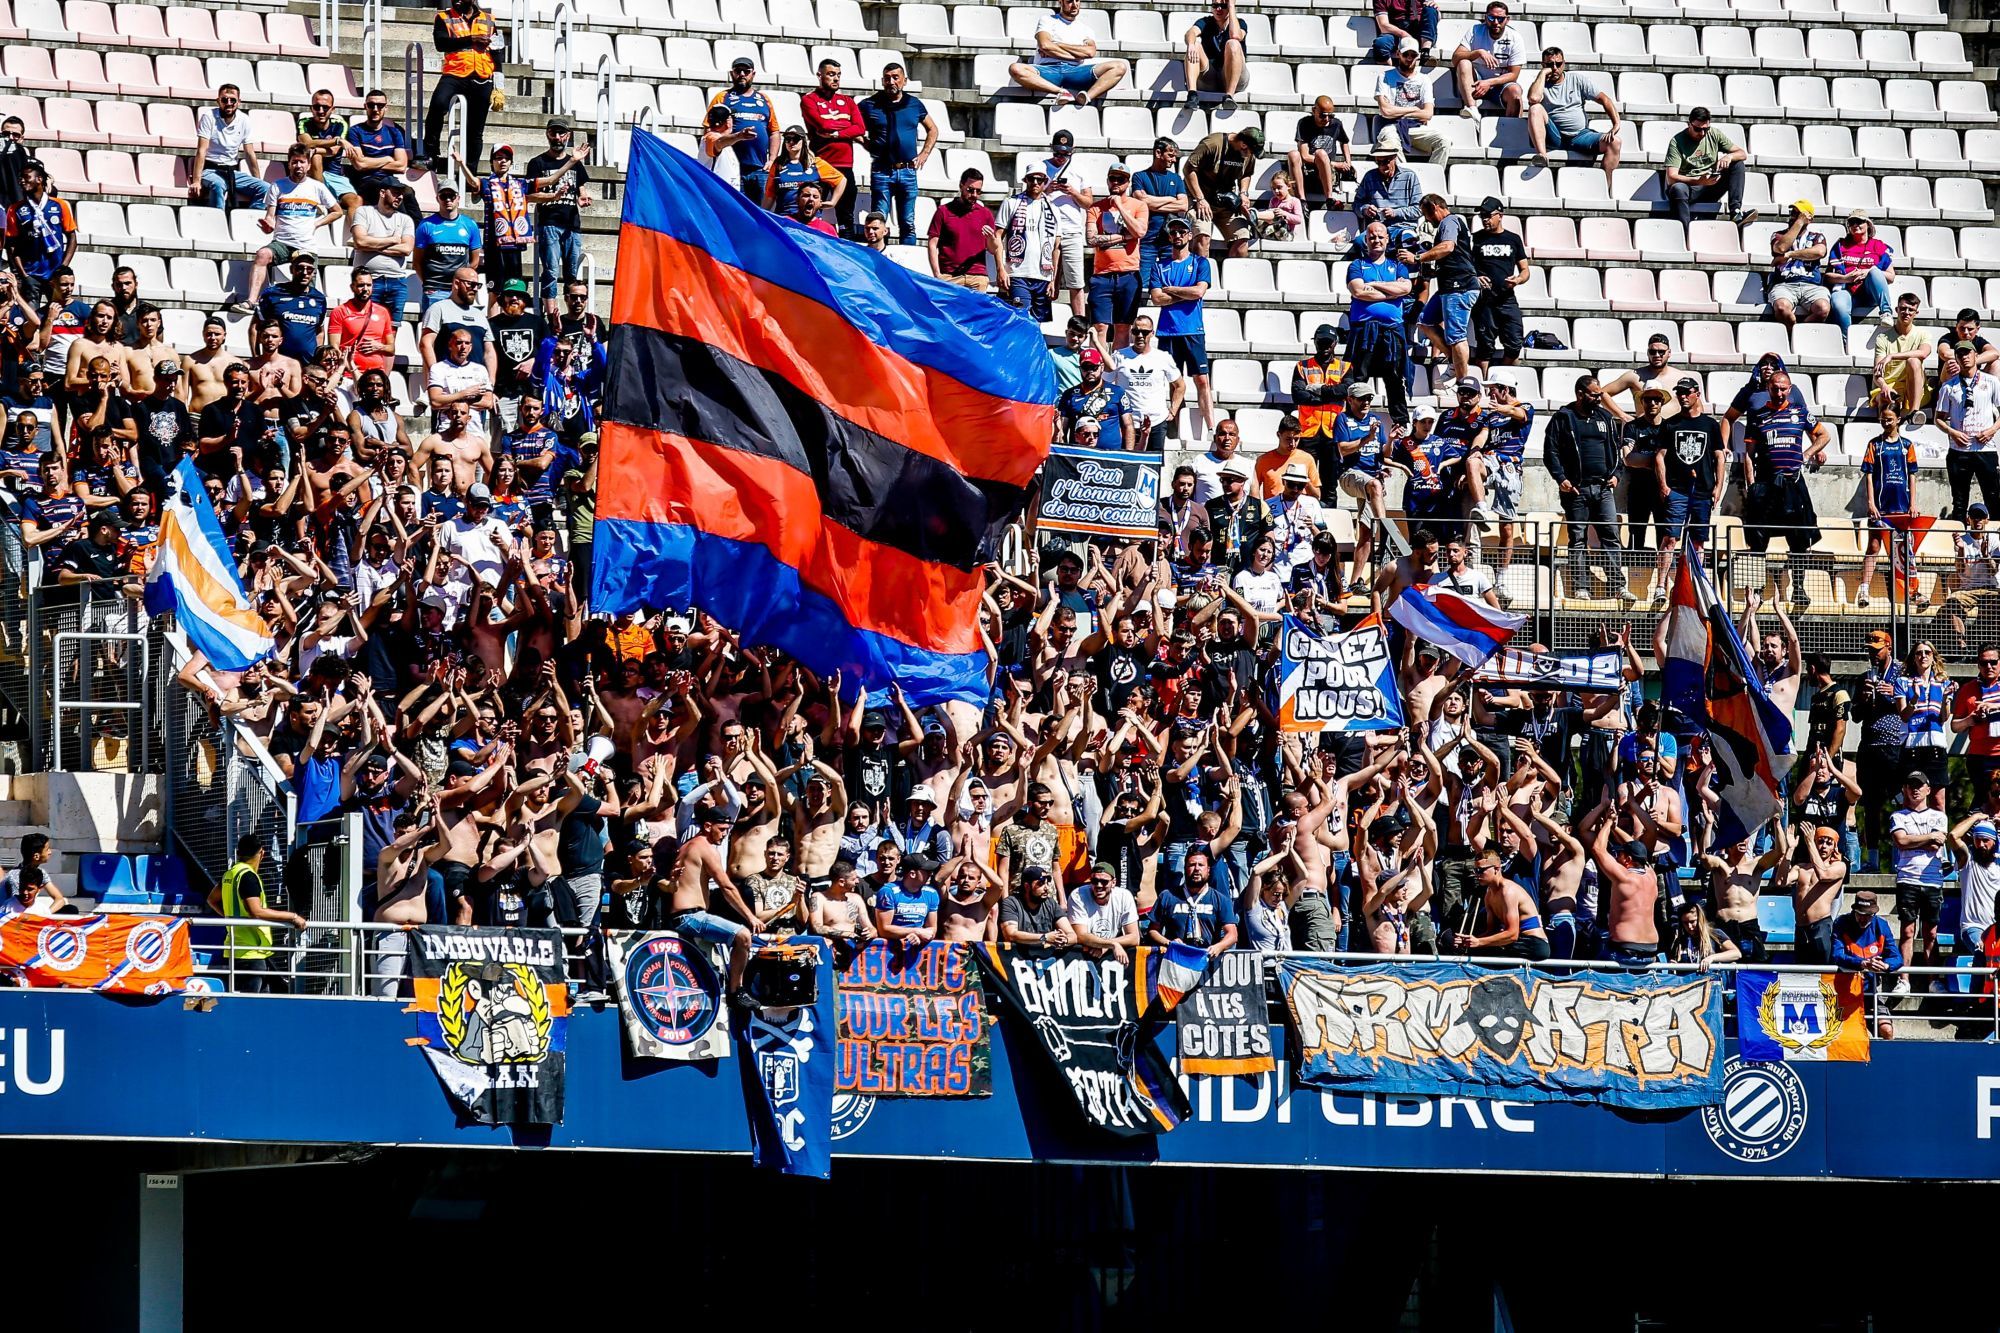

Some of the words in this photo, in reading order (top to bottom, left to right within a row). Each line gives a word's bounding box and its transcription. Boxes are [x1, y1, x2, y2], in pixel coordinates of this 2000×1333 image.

[283, 312, 317, 322] PROMAN
[1077, 461, 1124, 486] Pour
[1413, 479, 1441, 490] France
[1043, 500, 1066, 518] de
[1066, 503, 1100, 520] nos
[1298, 690, 1384, 718] NOUS!
[423, 935, 555, 966] IMBUVABLE
[652, 942, 679, 953] 1995
[641, 961, 662, 984] RONAN
[670, 961, 699, 988] POINTEAU
[913, 990, 980, 1043] LES
[1209, 992, 1245, 1018] TES
[1781, 1003, 1822, 1034] M
[663, 1030, 686, 1040] 2019
[1182, 1018, 1270, 1057] CÔTÉS
[836, 1039, 972, 1095] ULTRAS
[1784, 1077, 1802, 1112] Sport
[1782, 1114, 1803, 1141] Club
[1741, 1146, 1769, 1159] 1974
